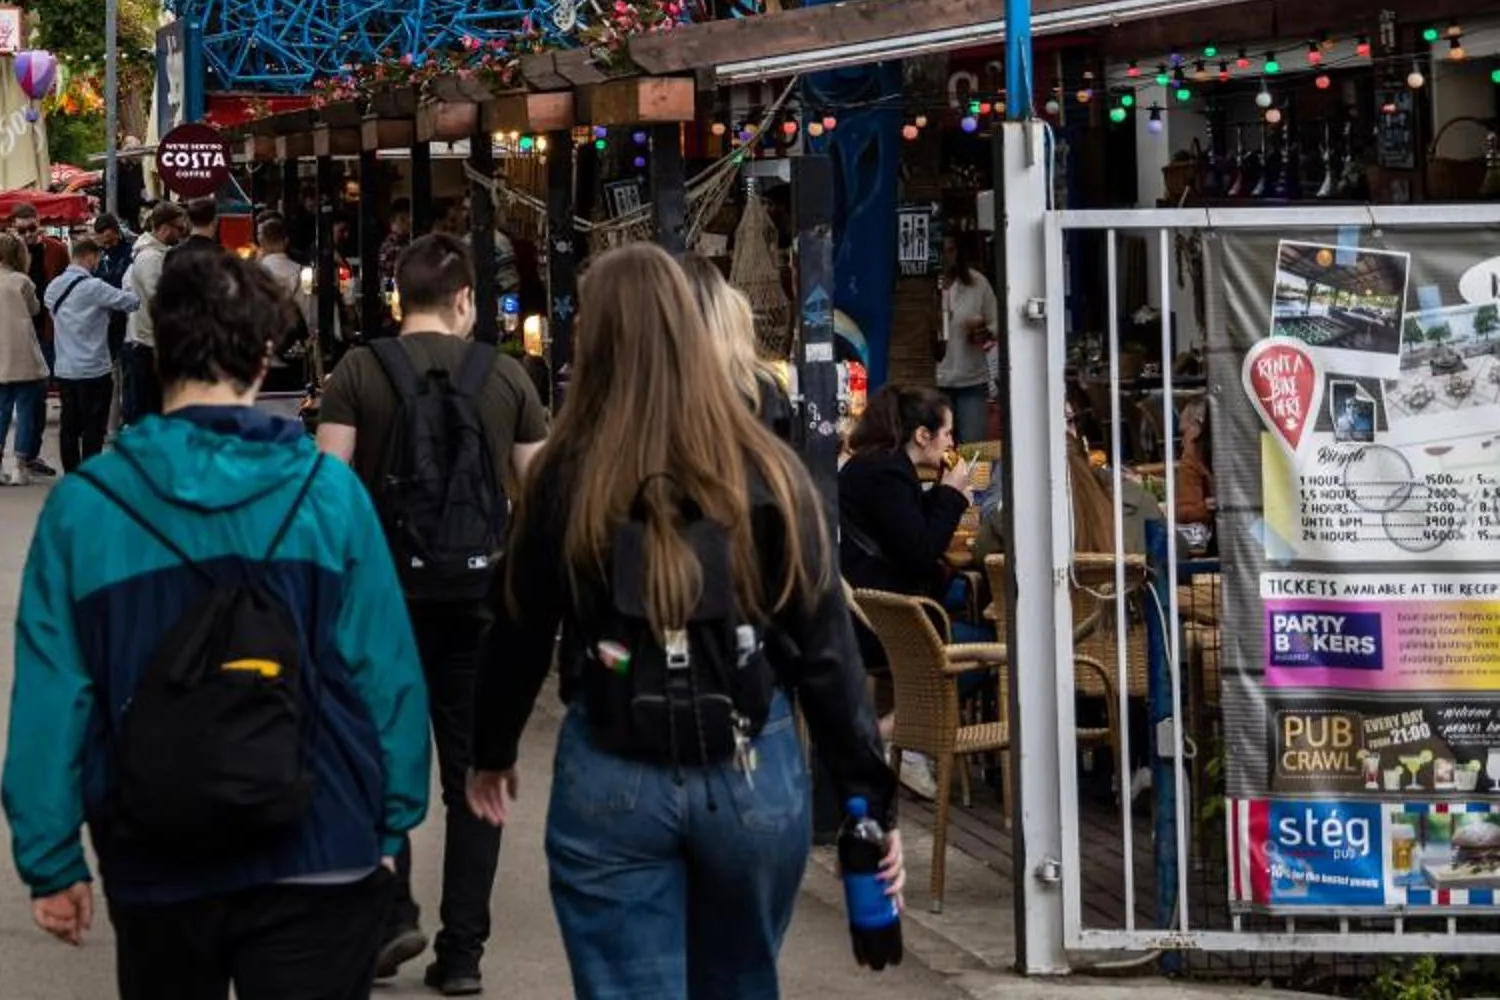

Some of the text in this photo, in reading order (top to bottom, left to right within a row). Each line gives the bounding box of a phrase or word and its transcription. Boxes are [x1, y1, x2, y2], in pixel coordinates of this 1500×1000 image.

[165, 143, 223, 151] WE'RE SERVING
[161, 151, 226, 169] COSTA
[175, 170, 212, 178] COFFEE
[1268, 579, 1337, 596] TICKETS
[1343, 583, 1406, 595] AVAILABLE
[1411, 583, 1425, 595] AT
[1432, 583, 1454, 595] THE
[1274, 614, 1346, 633] PARTY
[1364, 714, 1400, 733] EVERY
[1402, 709, 1424, 726] DAY
[1284, 715, 1353, 748] PUB
[1390, 723, 1431, 744] 21:00
[1283, 749, 1356, 771] CRAWL
[1279, 808, 1370, 857] stég
[1334, 848, 1356, 862] pub
